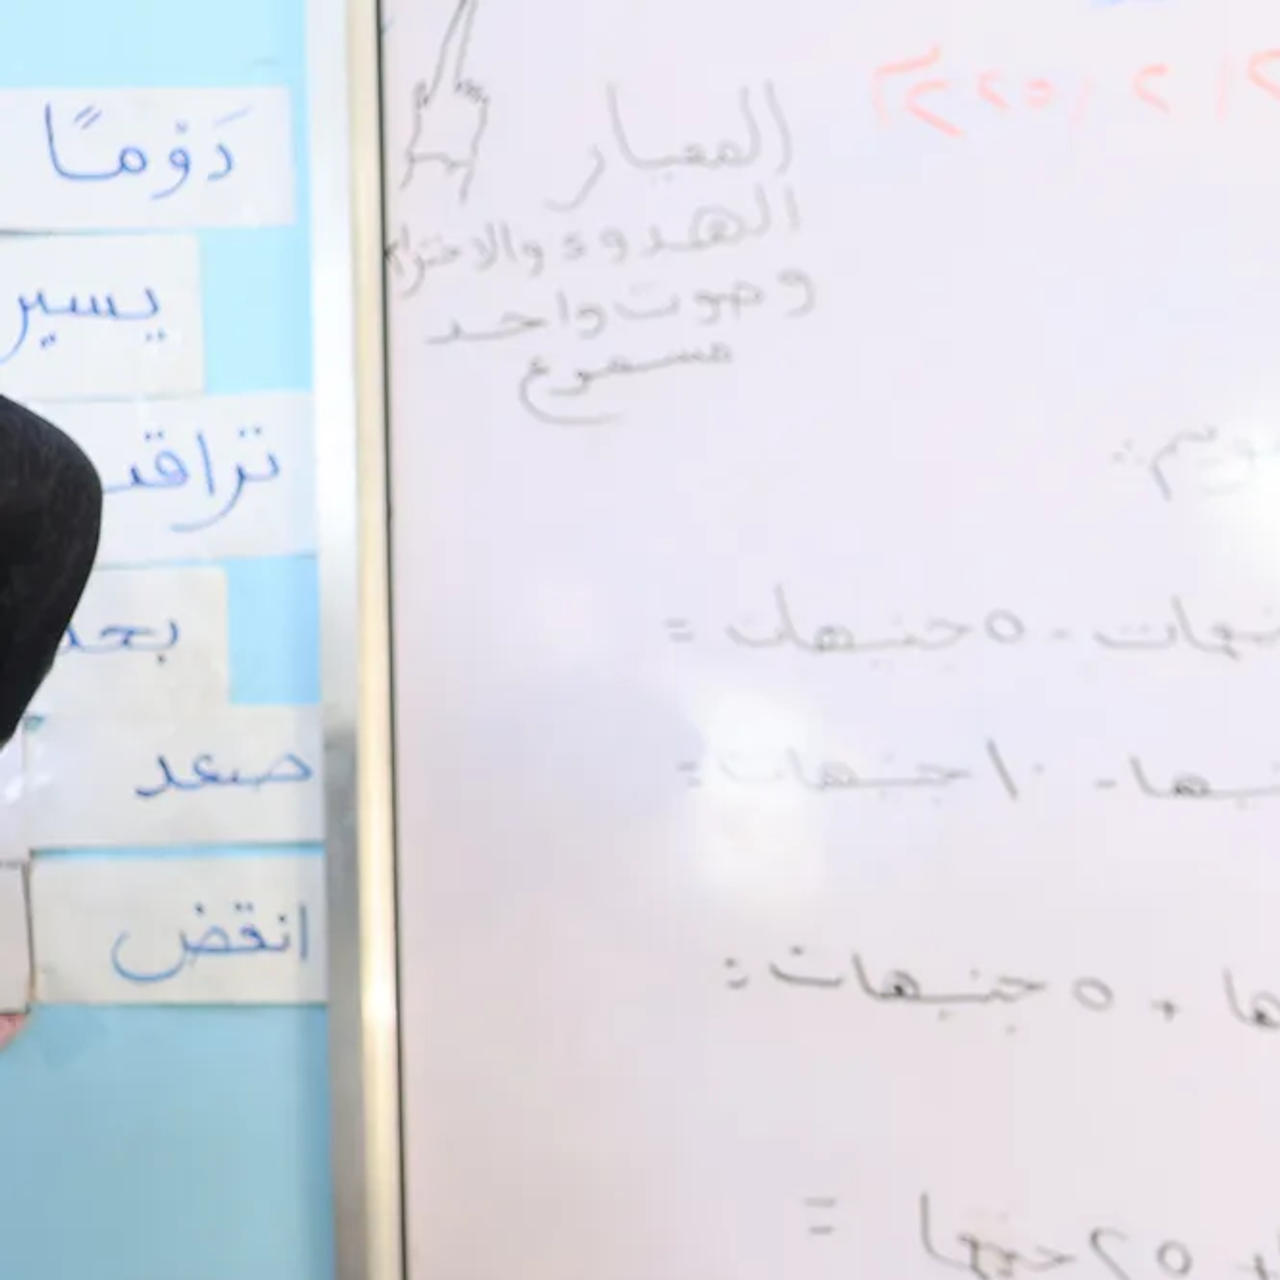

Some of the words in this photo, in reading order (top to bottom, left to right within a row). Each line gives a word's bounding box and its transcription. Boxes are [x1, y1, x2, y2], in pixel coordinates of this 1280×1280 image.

[543, 78, 793, 211] المعيار
[563, 183, 801, 264] الهدوء
[0, 287, 167, 365] يسير
[425, 290, 605, 340] واحد
[520, 341, 734, 424] مسموع
[135, 753, 313, 799] صعد
[111, 902, 308, 984] انقض
